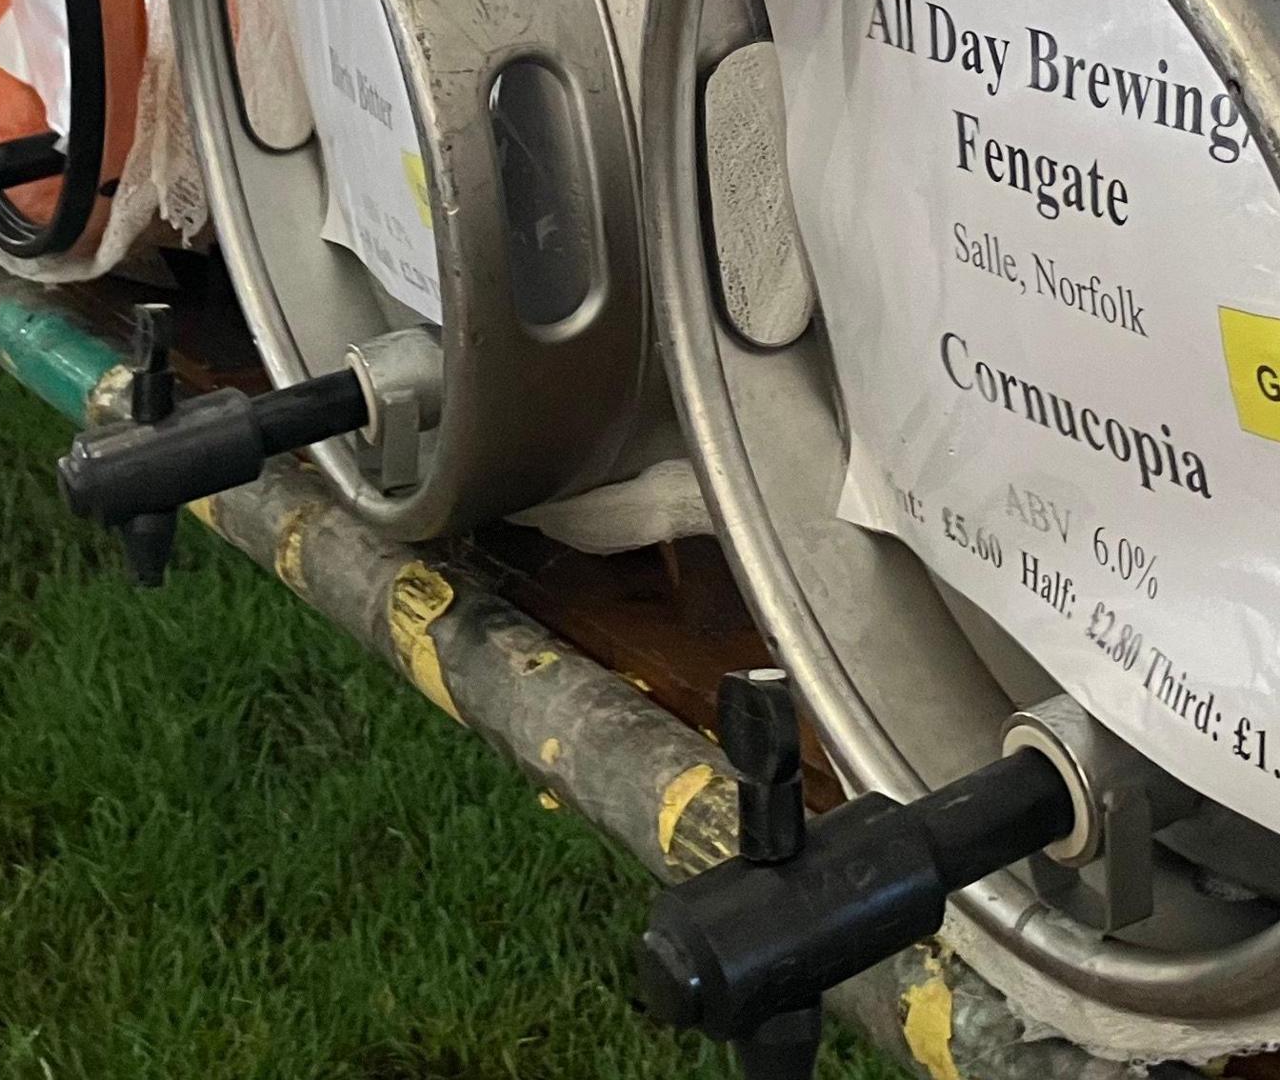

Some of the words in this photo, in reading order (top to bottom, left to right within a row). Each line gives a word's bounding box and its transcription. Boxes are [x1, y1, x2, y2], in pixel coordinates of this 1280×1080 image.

[926, 1, 1011, 96] Day
[952, 109, 1129, 226] Fengate
[953, 222, 1027, 295] Salle,
[1031, 252, 1149, 338] Norfolk
[940, 331, 1212, 499] Cornucopia
[1006, 483, 1071, 544] ABV
[1093, 526, 1158, 600] 6.0%
[942, 506, 1002, 568] £5.60
[1020, 548, 1076, 619] Half:
[1085, 602, 1143, 671] £2.80
[1142, 647, 1222, 742] Third:
